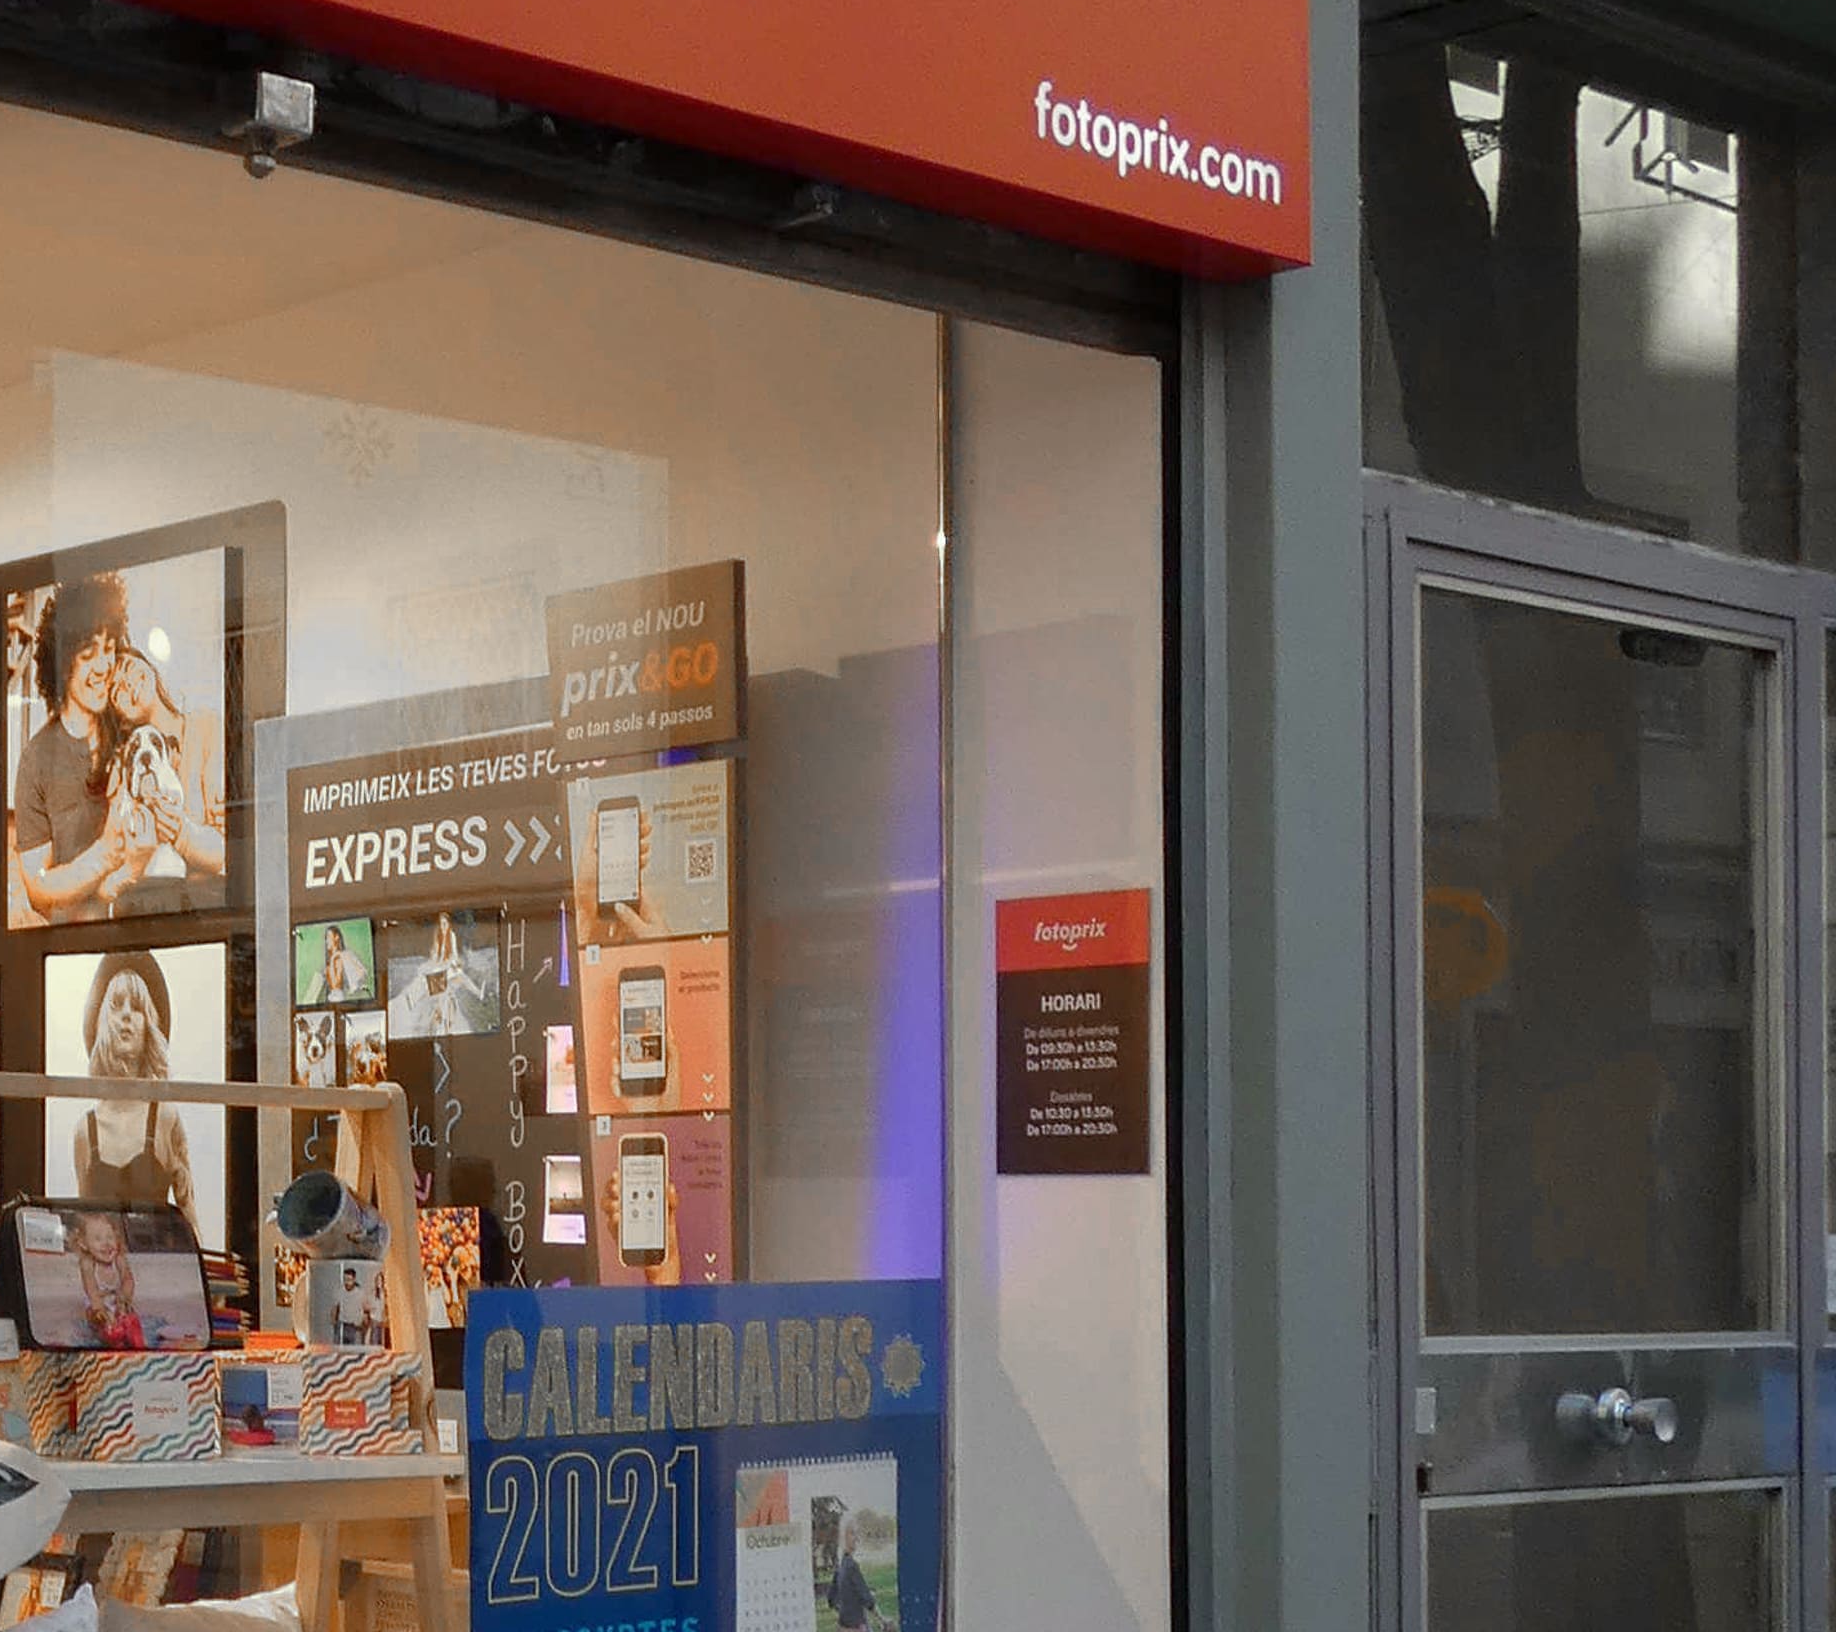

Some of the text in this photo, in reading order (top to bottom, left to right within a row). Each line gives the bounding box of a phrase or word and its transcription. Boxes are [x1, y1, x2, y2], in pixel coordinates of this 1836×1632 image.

[1033, 80, 1282, 206] fotoprix.com
[570, 599, 706, 649] Prova el NOU
[565, 704, 715, 742] en tan sols 4 passos
[303, 770, 412, 815] IMPRIMEIX
[415, 765, 455, 798] LES
[459, 752, 528, 789] TEVES
[305, 815, 489, 890] EXPRESS
[1033, 917, 1108, 944] fotoprix
[1040, 992, 1102, 1013] HORARI
[482, 1315, 874, 1442] CALENDARIS
[485, 1444, 701, 1604] 2021
